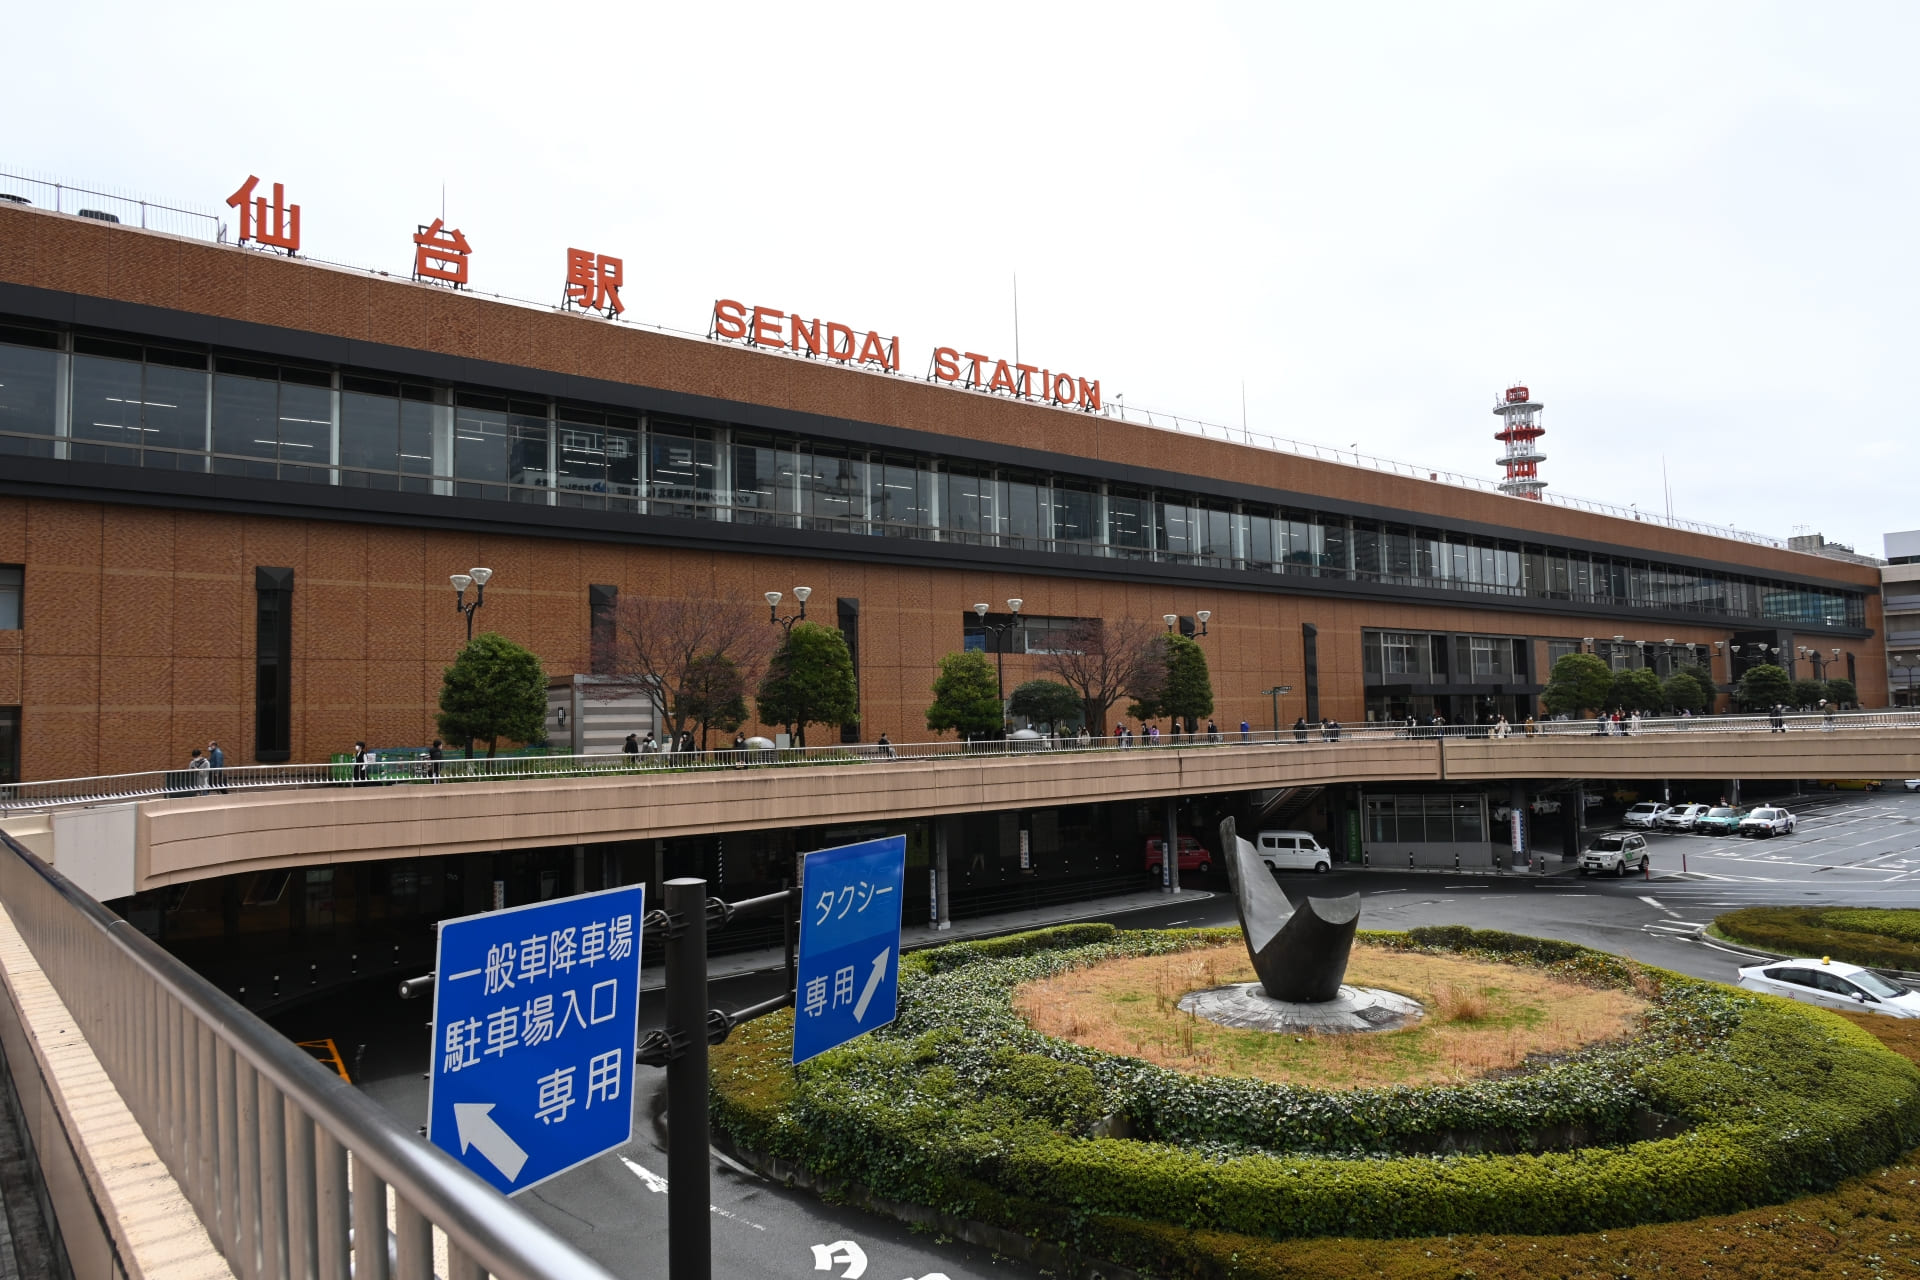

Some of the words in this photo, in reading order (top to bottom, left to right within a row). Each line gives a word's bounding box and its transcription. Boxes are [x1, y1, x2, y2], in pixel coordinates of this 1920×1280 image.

[226, 175, 626, 313] 仙台駅
[716, 300, 900, 371] SENDAI
[935, 346, 1101, 411] STATION
[815, 881, 894, 926] タクシー
[447, 914, 633, 995] 一般車降車場
[803, 965, 857, 1018] 専用
[442, 978, 618, 1074] 駐車場入口
[533, 1048, 623, 1125] 専用
